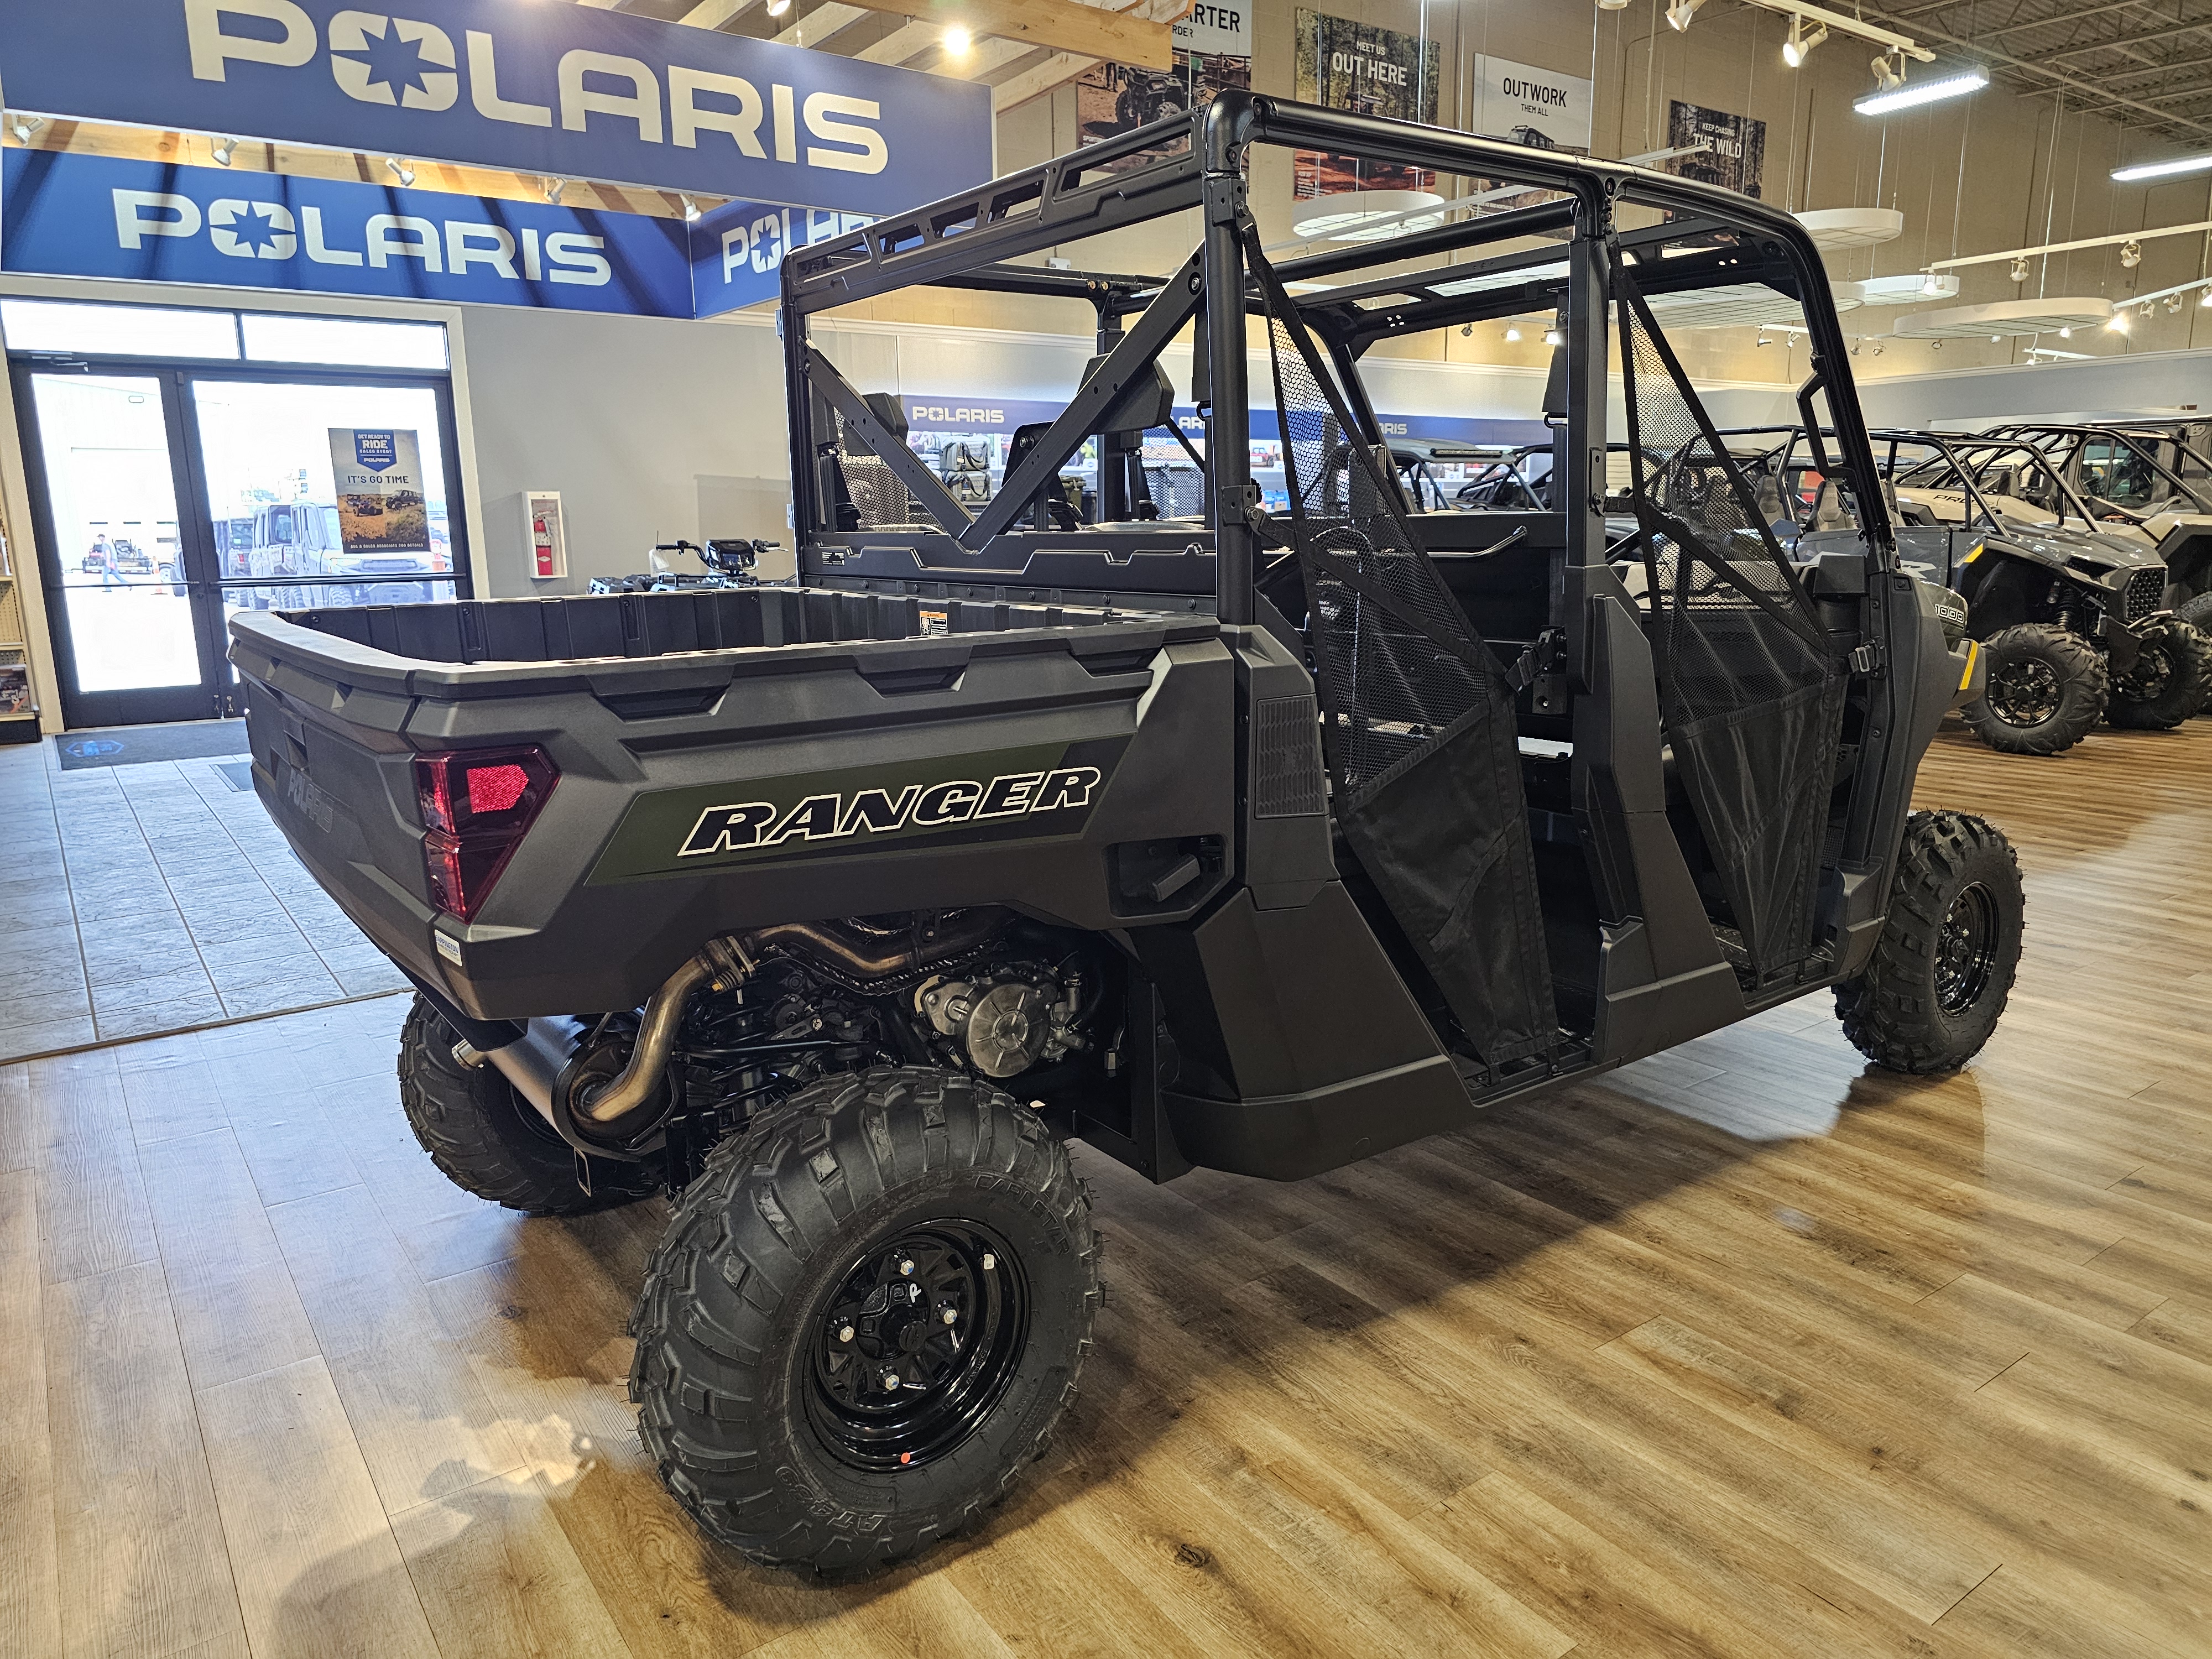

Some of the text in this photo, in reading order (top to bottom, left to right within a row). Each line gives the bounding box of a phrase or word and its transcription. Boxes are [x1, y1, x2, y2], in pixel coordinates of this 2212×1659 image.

[1357, 40, 1386, 56] MEET US
[1332, 51, 1407, 86] OUT HERE
[184, 0, 889, 175] POLARIS
[1503, 77, 1567, 108] OUTWORK
[1521, 103, 1549, 117] THEM ALL
[1702, 122, 1735, 137] KEEP CHASING
[1693, 133, 1742, 159] THE WILD
[112, 188, 612, 286] POLARIS
[912, 405, 1005, 424] POLARIS
[362, 439, 388, 450] RIDE
[347, 475, 367, 483] IT'S
[677, 766, 1101, 857] RANGER
